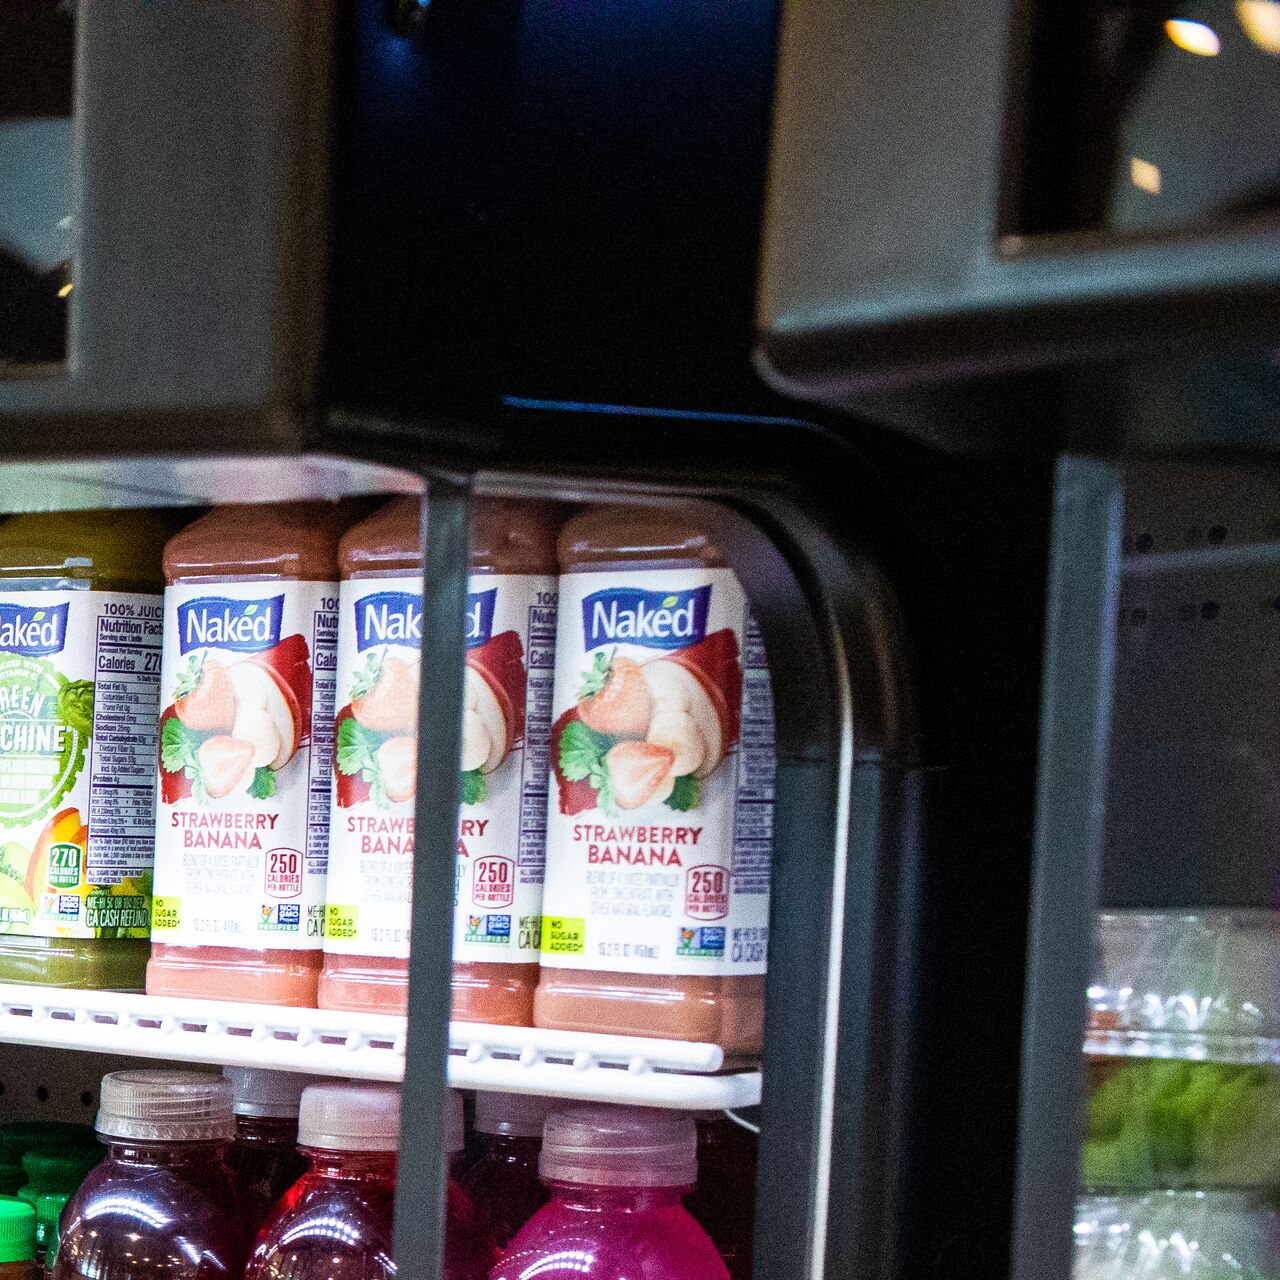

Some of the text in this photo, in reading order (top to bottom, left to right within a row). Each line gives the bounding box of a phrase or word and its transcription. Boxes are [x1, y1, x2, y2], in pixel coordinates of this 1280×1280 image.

[104, 603, 136, 616] 100%
[592, 599, 695, 639] Naked
[100, 620, 142, 635] Nutrition
[187, 605, 271, 642] Naked
[98, 656, 136, 670] Calories
[171, 812, 280, 830] STRAWBERRY
[183, 830, 262, 850] BANANA
[572, 825, 703, 844] STRAWBERRY
[51, 848, 76, 867] 270
[270, 853, 297, 874] 250
[588, 844, 682, 866] BANANA
[478, 862, 506, 883] 250
